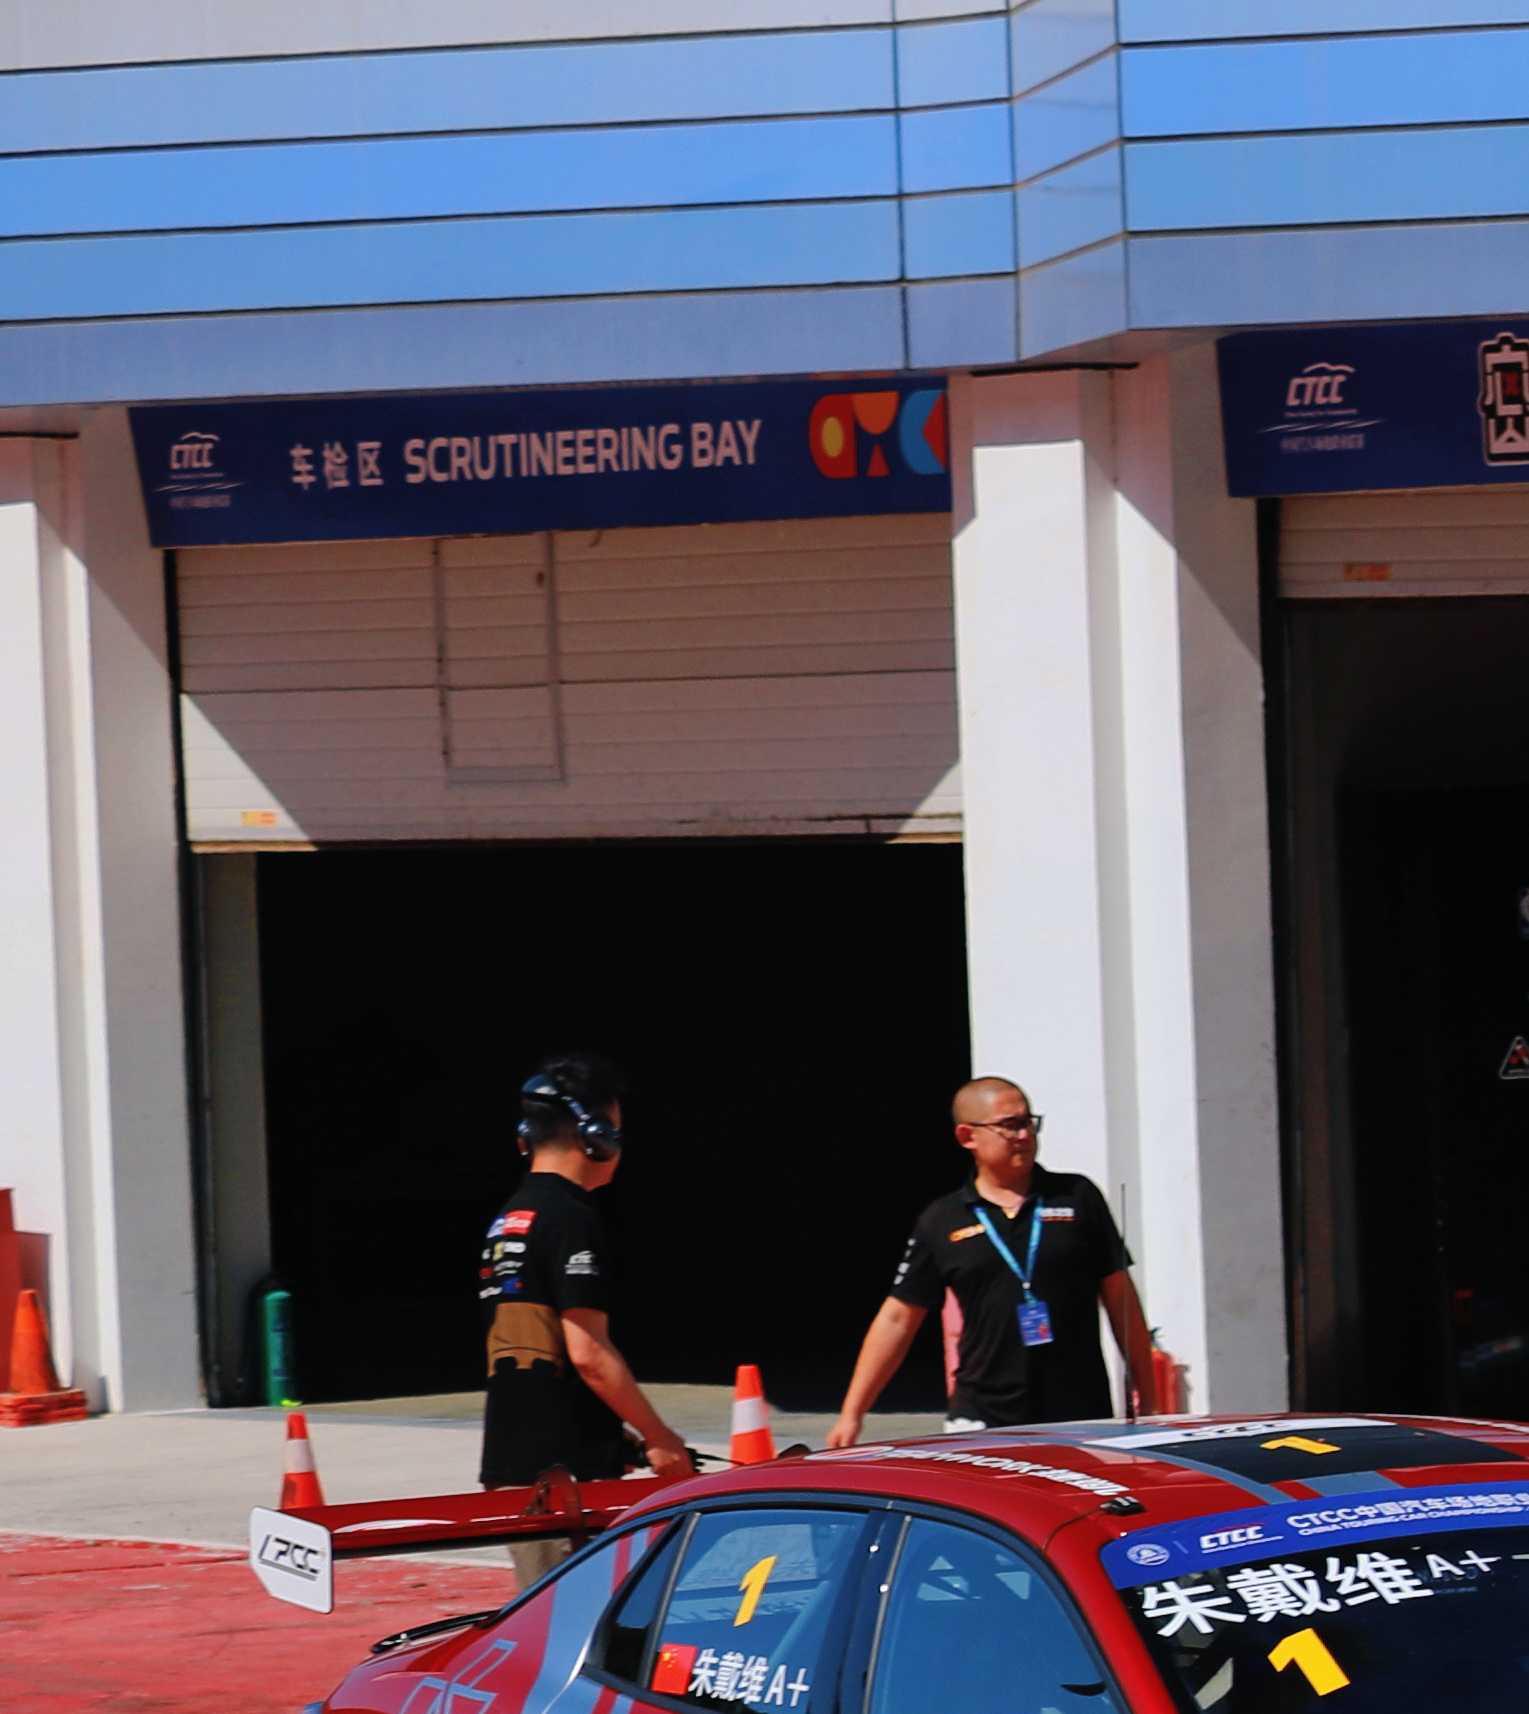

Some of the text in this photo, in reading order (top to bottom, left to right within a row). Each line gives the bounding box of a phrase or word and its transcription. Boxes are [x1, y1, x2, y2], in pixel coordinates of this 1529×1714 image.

[1286, 375, 1348, 407] CTCC
[289, 443, 385, 491] 车检区
[403, 418, 763, 486] SCRUTINEERING BAY
[1260, 1436, 1341, 1455] 1
[1199, 1525, 1264, 1551] CTCC
[733, 1555, 778, 1628] 1
[1267, 1627, 1351, 1697] 1
